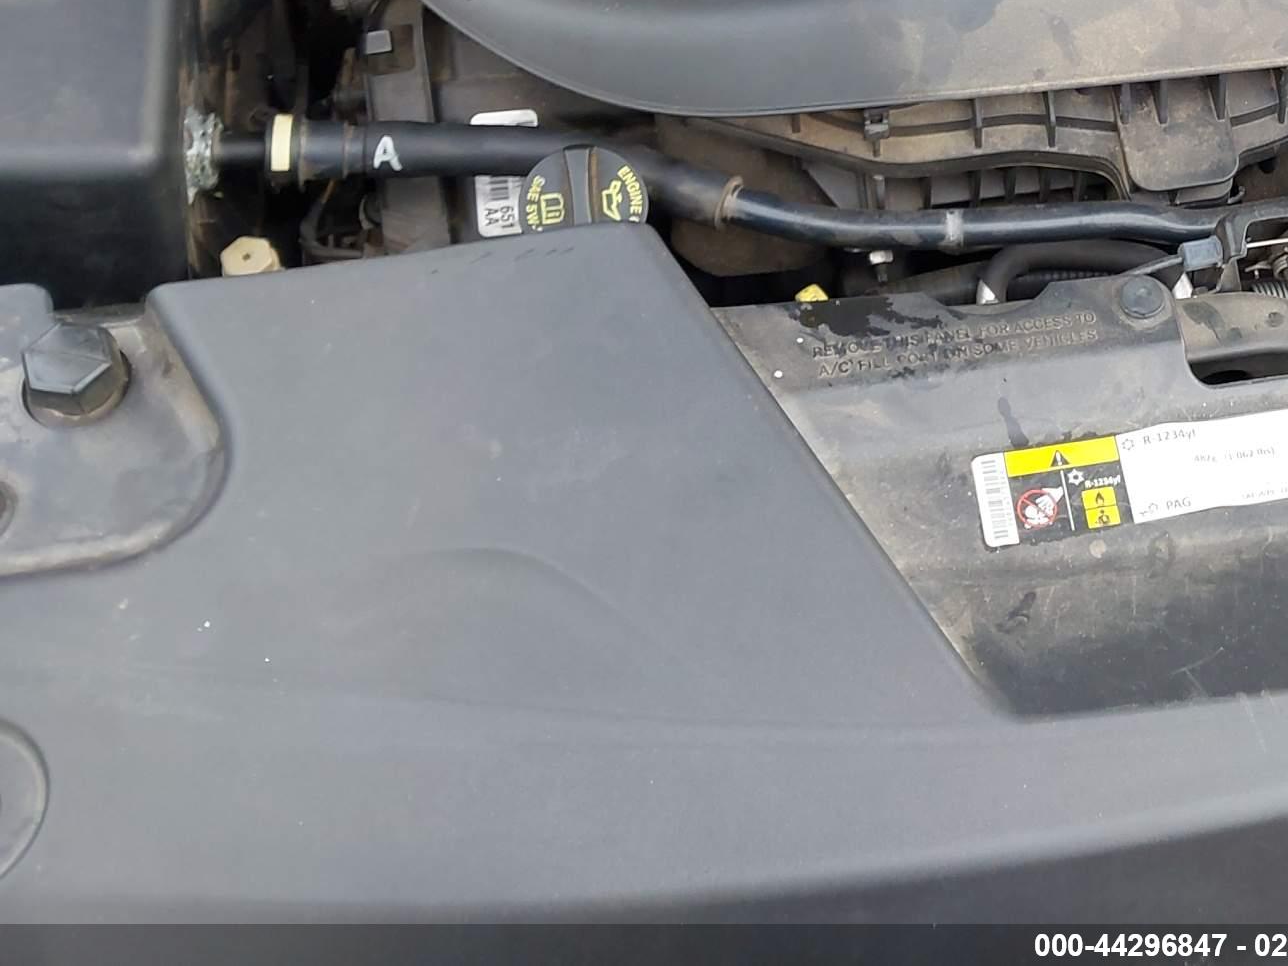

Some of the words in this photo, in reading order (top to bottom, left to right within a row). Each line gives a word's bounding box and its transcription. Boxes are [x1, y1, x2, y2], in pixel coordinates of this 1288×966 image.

[373, 135, 403, 171] A
[527, 175, 546, 202] SAE
[617, 165, 644, 215] ENGINE
[813, 340, 882, 360] REMOVE
[883, 333, 920, 351] THIS
[924, 326, 972, 344] PANEL
[979, 322, 1011, 339] FOR
[1014, 315, 1073, 334] ACCESS
[1076, 313, 1097, 325] TO
[817, 360, 852, 380] A/C
[858, 357, 893, 372] FILL
[974, 338, 1017, 356] SOME
[1024, 329, 1099, 352] VEHICLES
[1085, 474, 1121, 489] R-1234yf
[1165, 497, 1192, 510] PAG
